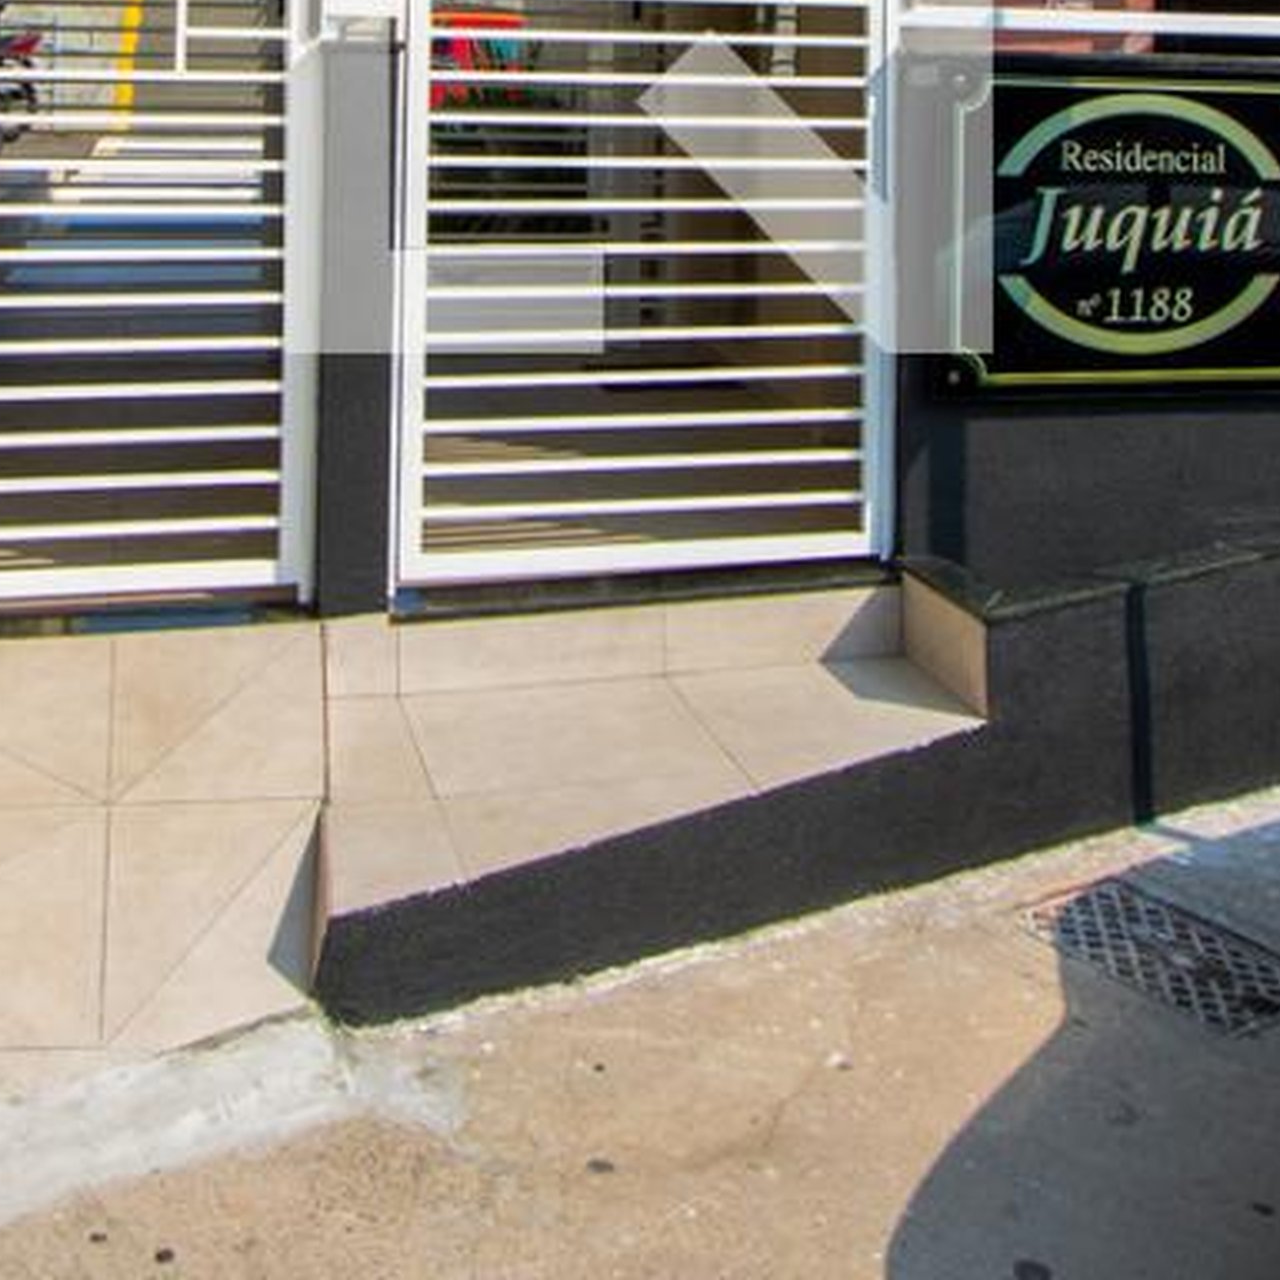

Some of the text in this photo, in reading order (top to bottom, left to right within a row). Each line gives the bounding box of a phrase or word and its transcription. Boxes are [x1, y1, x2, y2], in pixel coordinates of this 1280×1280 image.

[1061, 139, 1226, 174] Residencial
[1020, 186, 1264, 275] Juquiá
[1103, 286, 1194, 323] 1188
